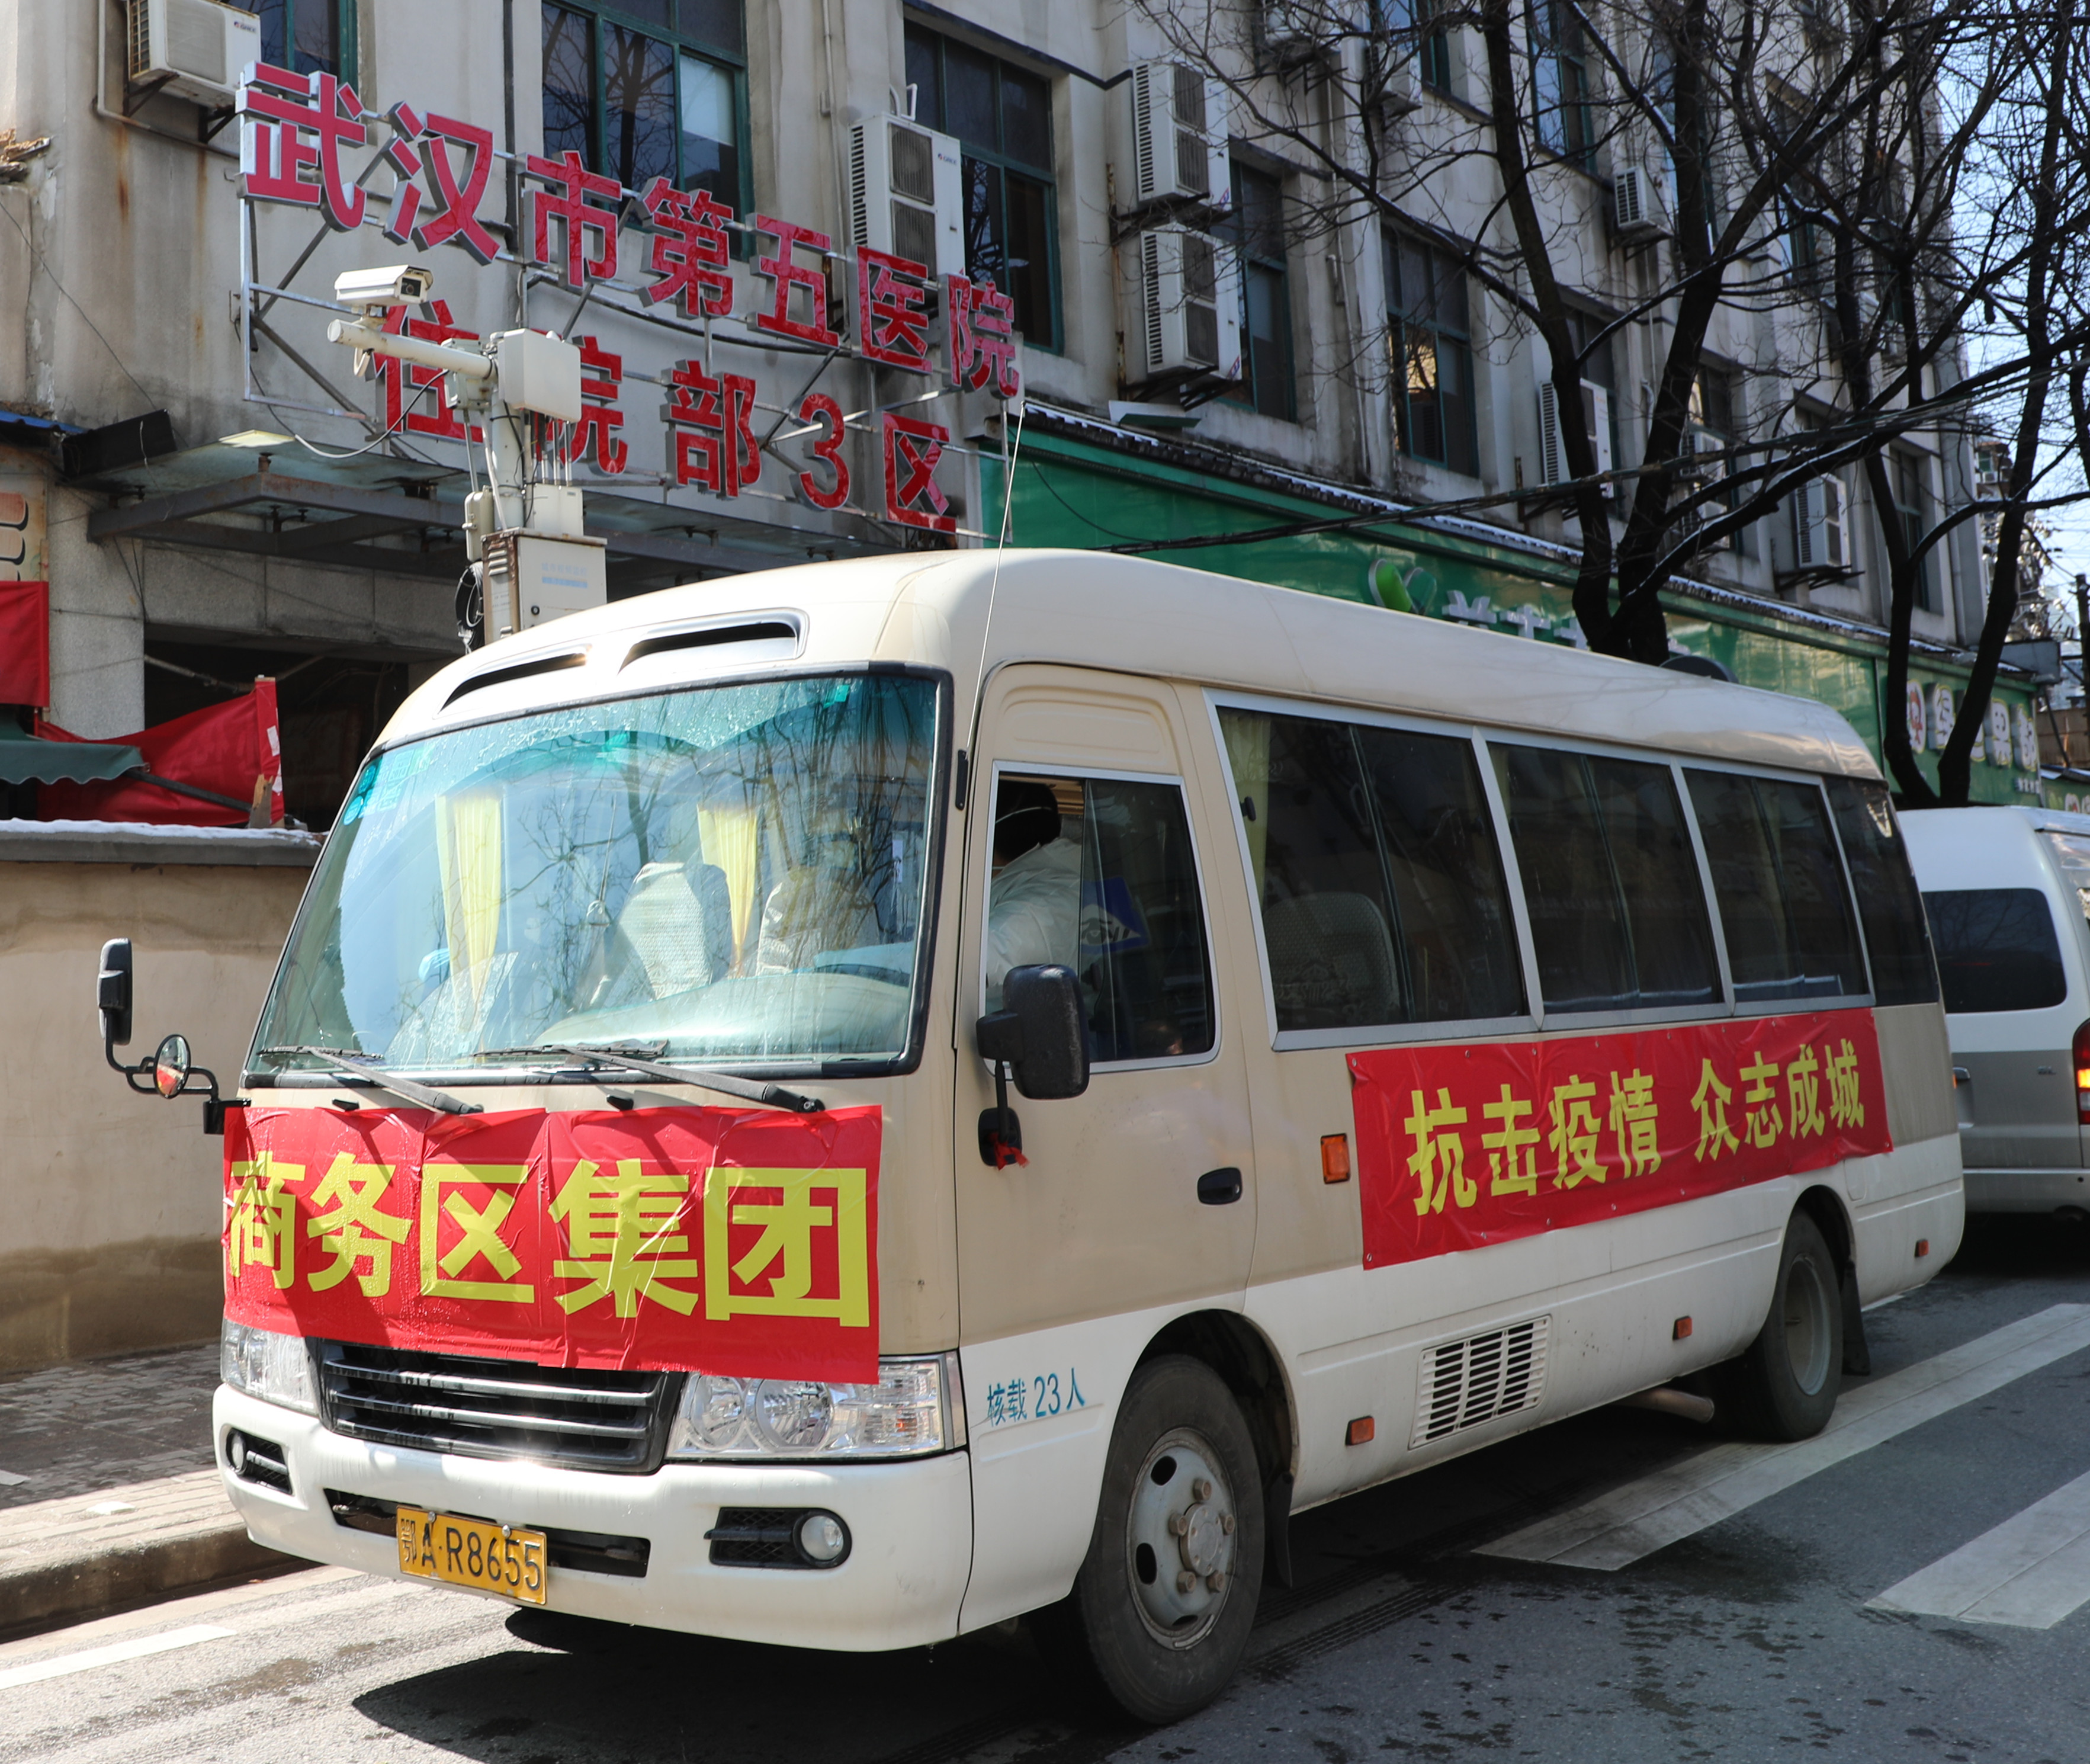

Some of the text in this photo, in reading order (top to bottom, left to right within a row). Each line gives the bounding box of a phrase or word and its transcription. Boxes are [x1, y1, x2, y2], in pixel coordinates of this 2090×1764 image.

[238, 61, 1019, 399] 武汉市第五医院
[1404, 1038, 1866, 1217] 抗击疫情 众志成城
[229, 1150, 871, 1327] 商务区集团
[987, 1367, 1086, 1427] 核载23人
